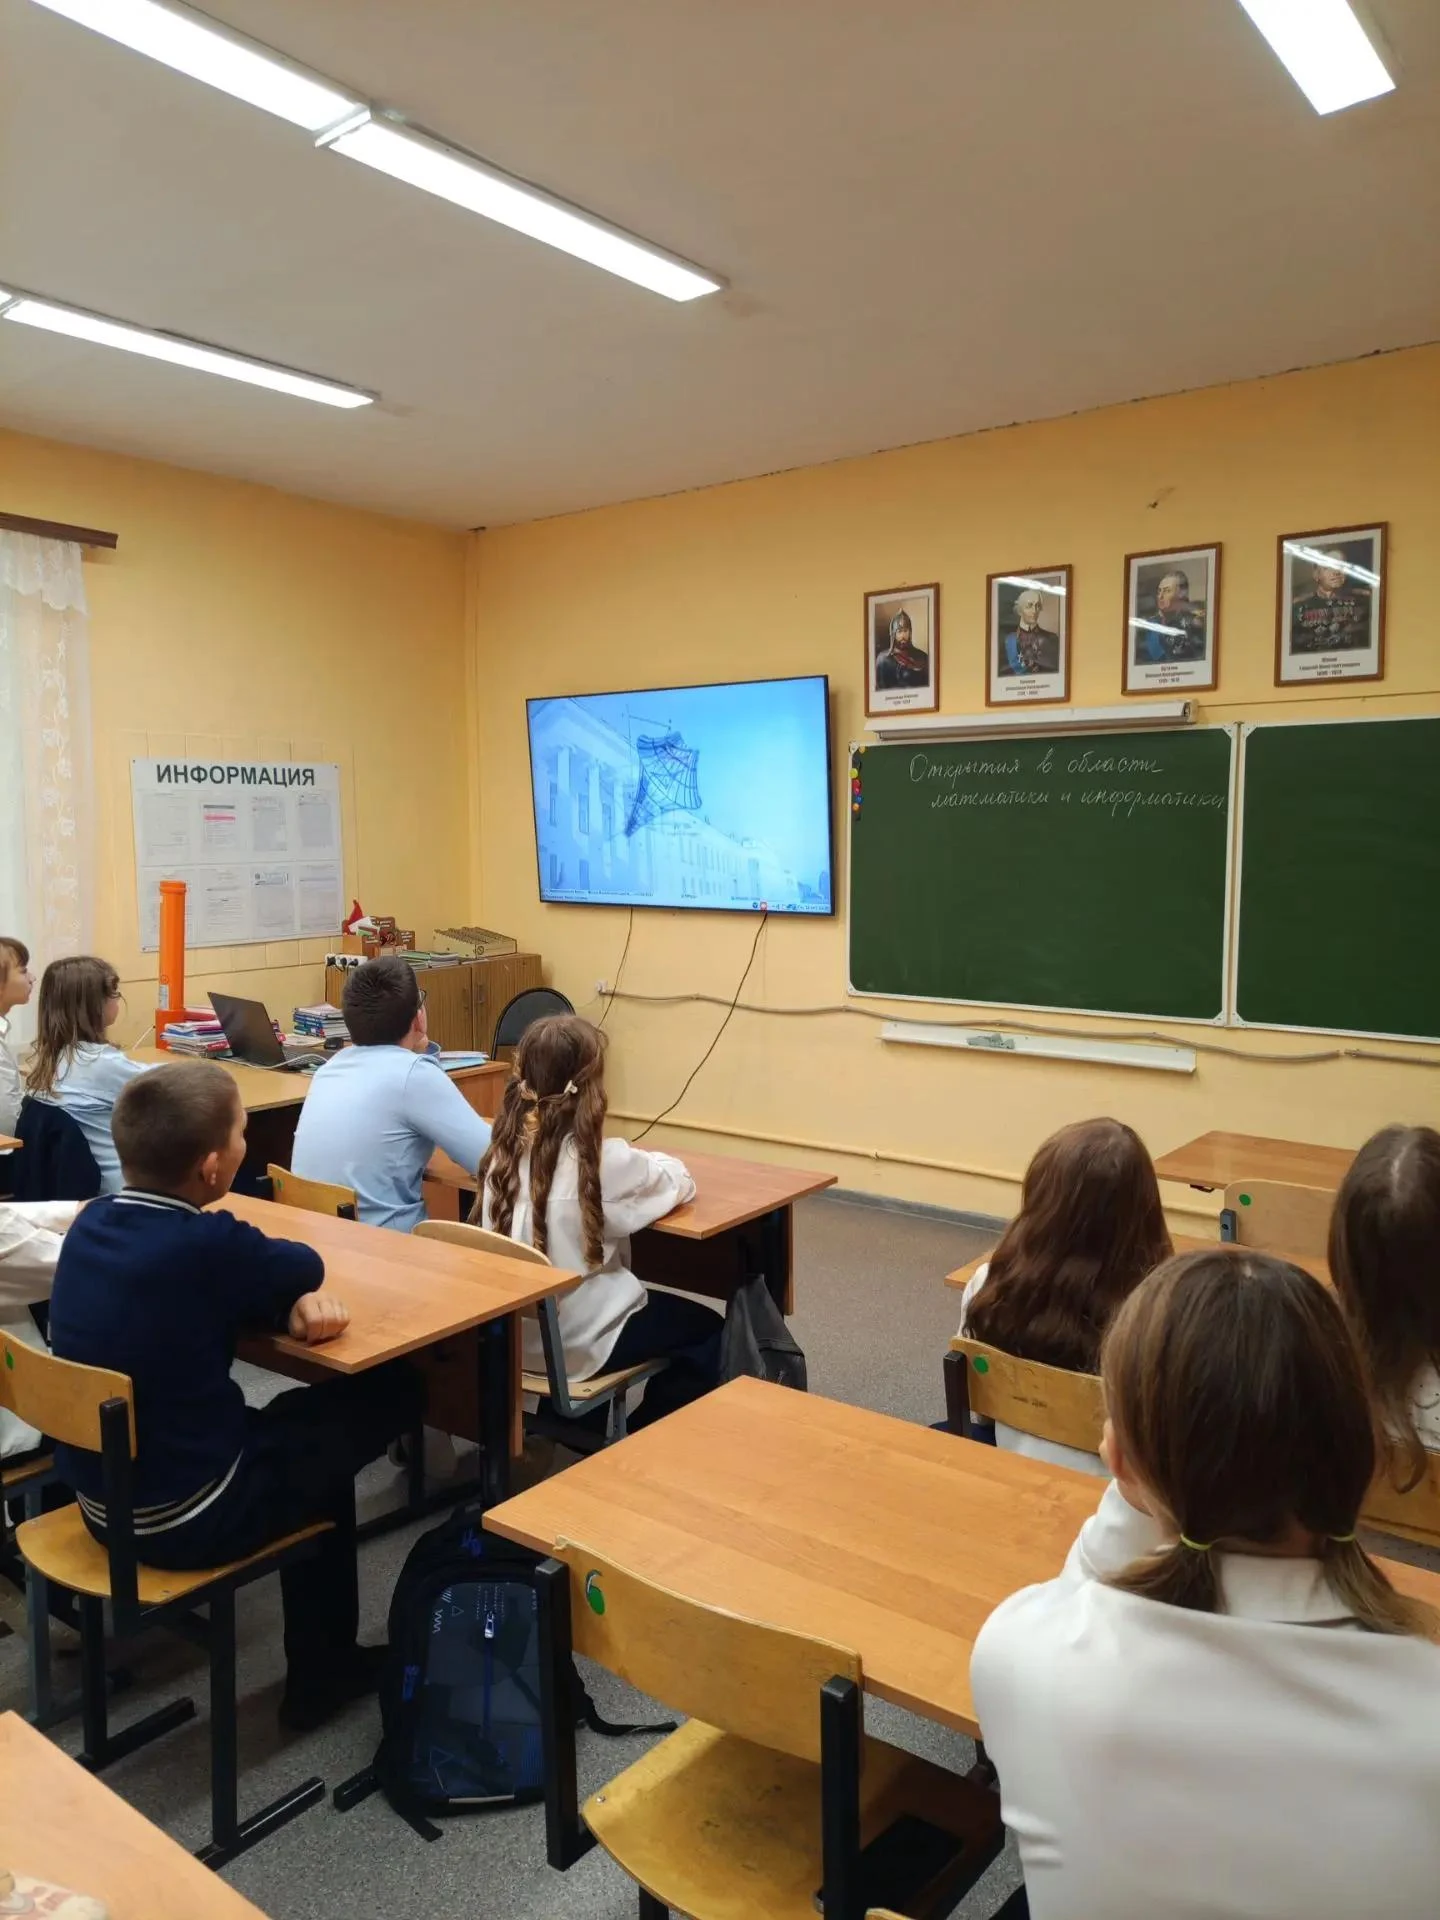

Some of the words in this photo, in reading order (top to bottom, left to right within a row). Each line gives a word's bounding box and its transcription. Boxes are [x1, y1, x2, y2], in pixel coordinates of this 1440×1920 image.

[156, 764, 315, 788] ИНФОРМАЦИЯ
[909, 753, 1020, 789] Открытия
[1036, 748, 1053, 774] в
[1067, 750, 1164, 773] области
[931, 790, 1049, 809] математики
[1060, 792, 1072, 803] и
